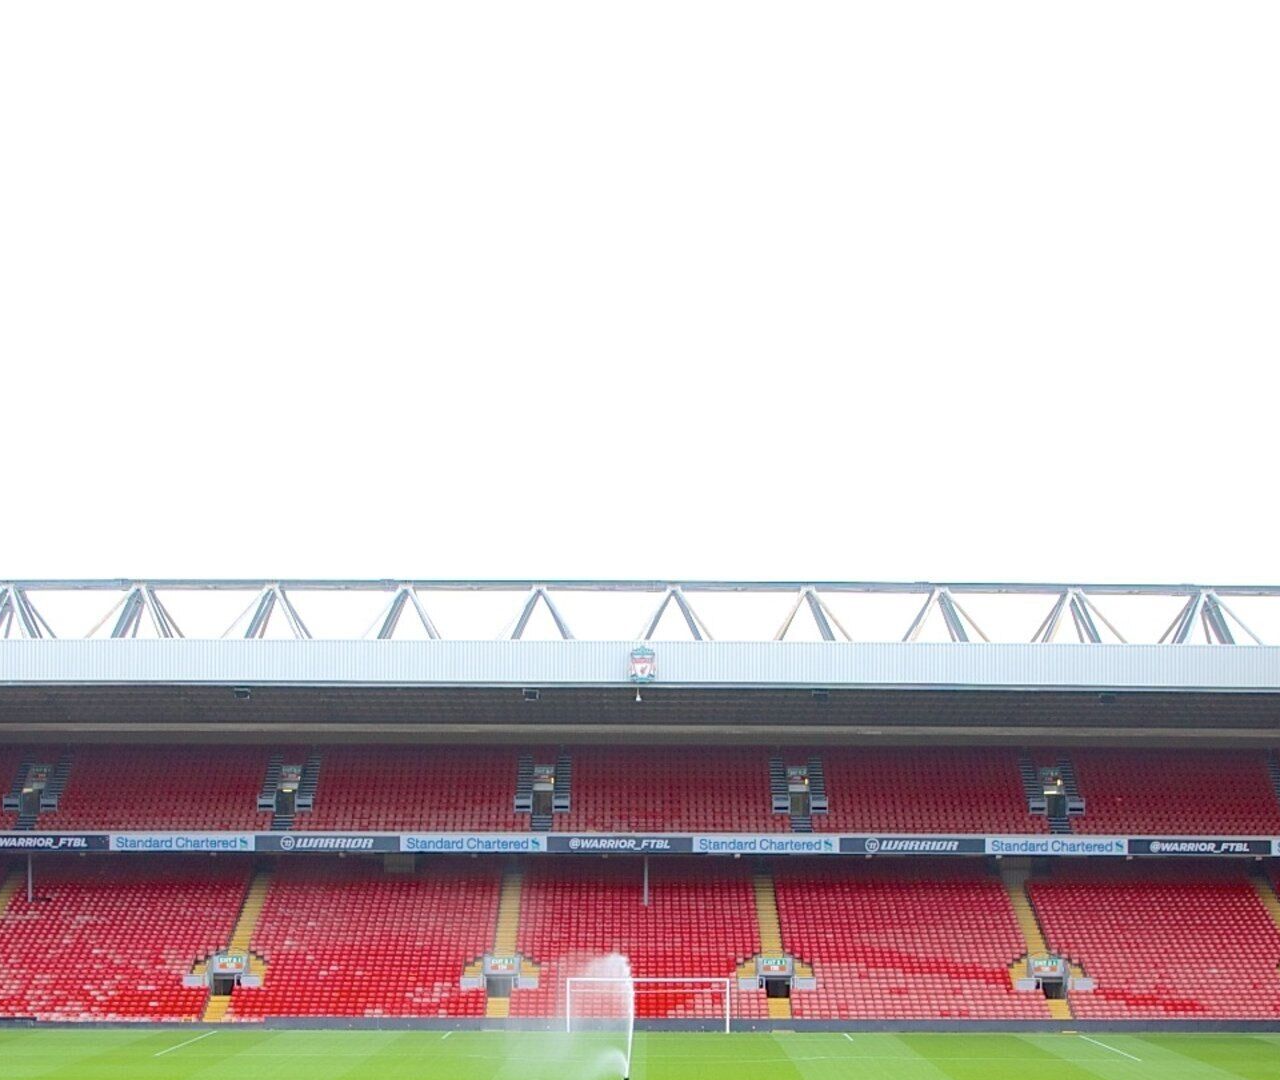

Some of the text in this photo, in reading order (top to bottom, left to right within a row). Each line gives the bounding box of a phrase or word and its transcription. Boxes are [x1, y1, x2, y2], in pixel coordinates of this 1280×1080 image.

[116, 837, 238, 849] Standard Chartered
[296, 837, 374, 849] WARRIOR
[407, 837, 529, 850] Standard Chartered
[570, 838, 670, 851] @WARRIOR_FTBL
[700, 839, 822, 851] Standard Chartered
[881, 840, 959, 851] WARRIOR
[992, 840, 1113, 853] Standard Chartered
[1150, 841, 1249, 853] @WARRIOR_FTBL
